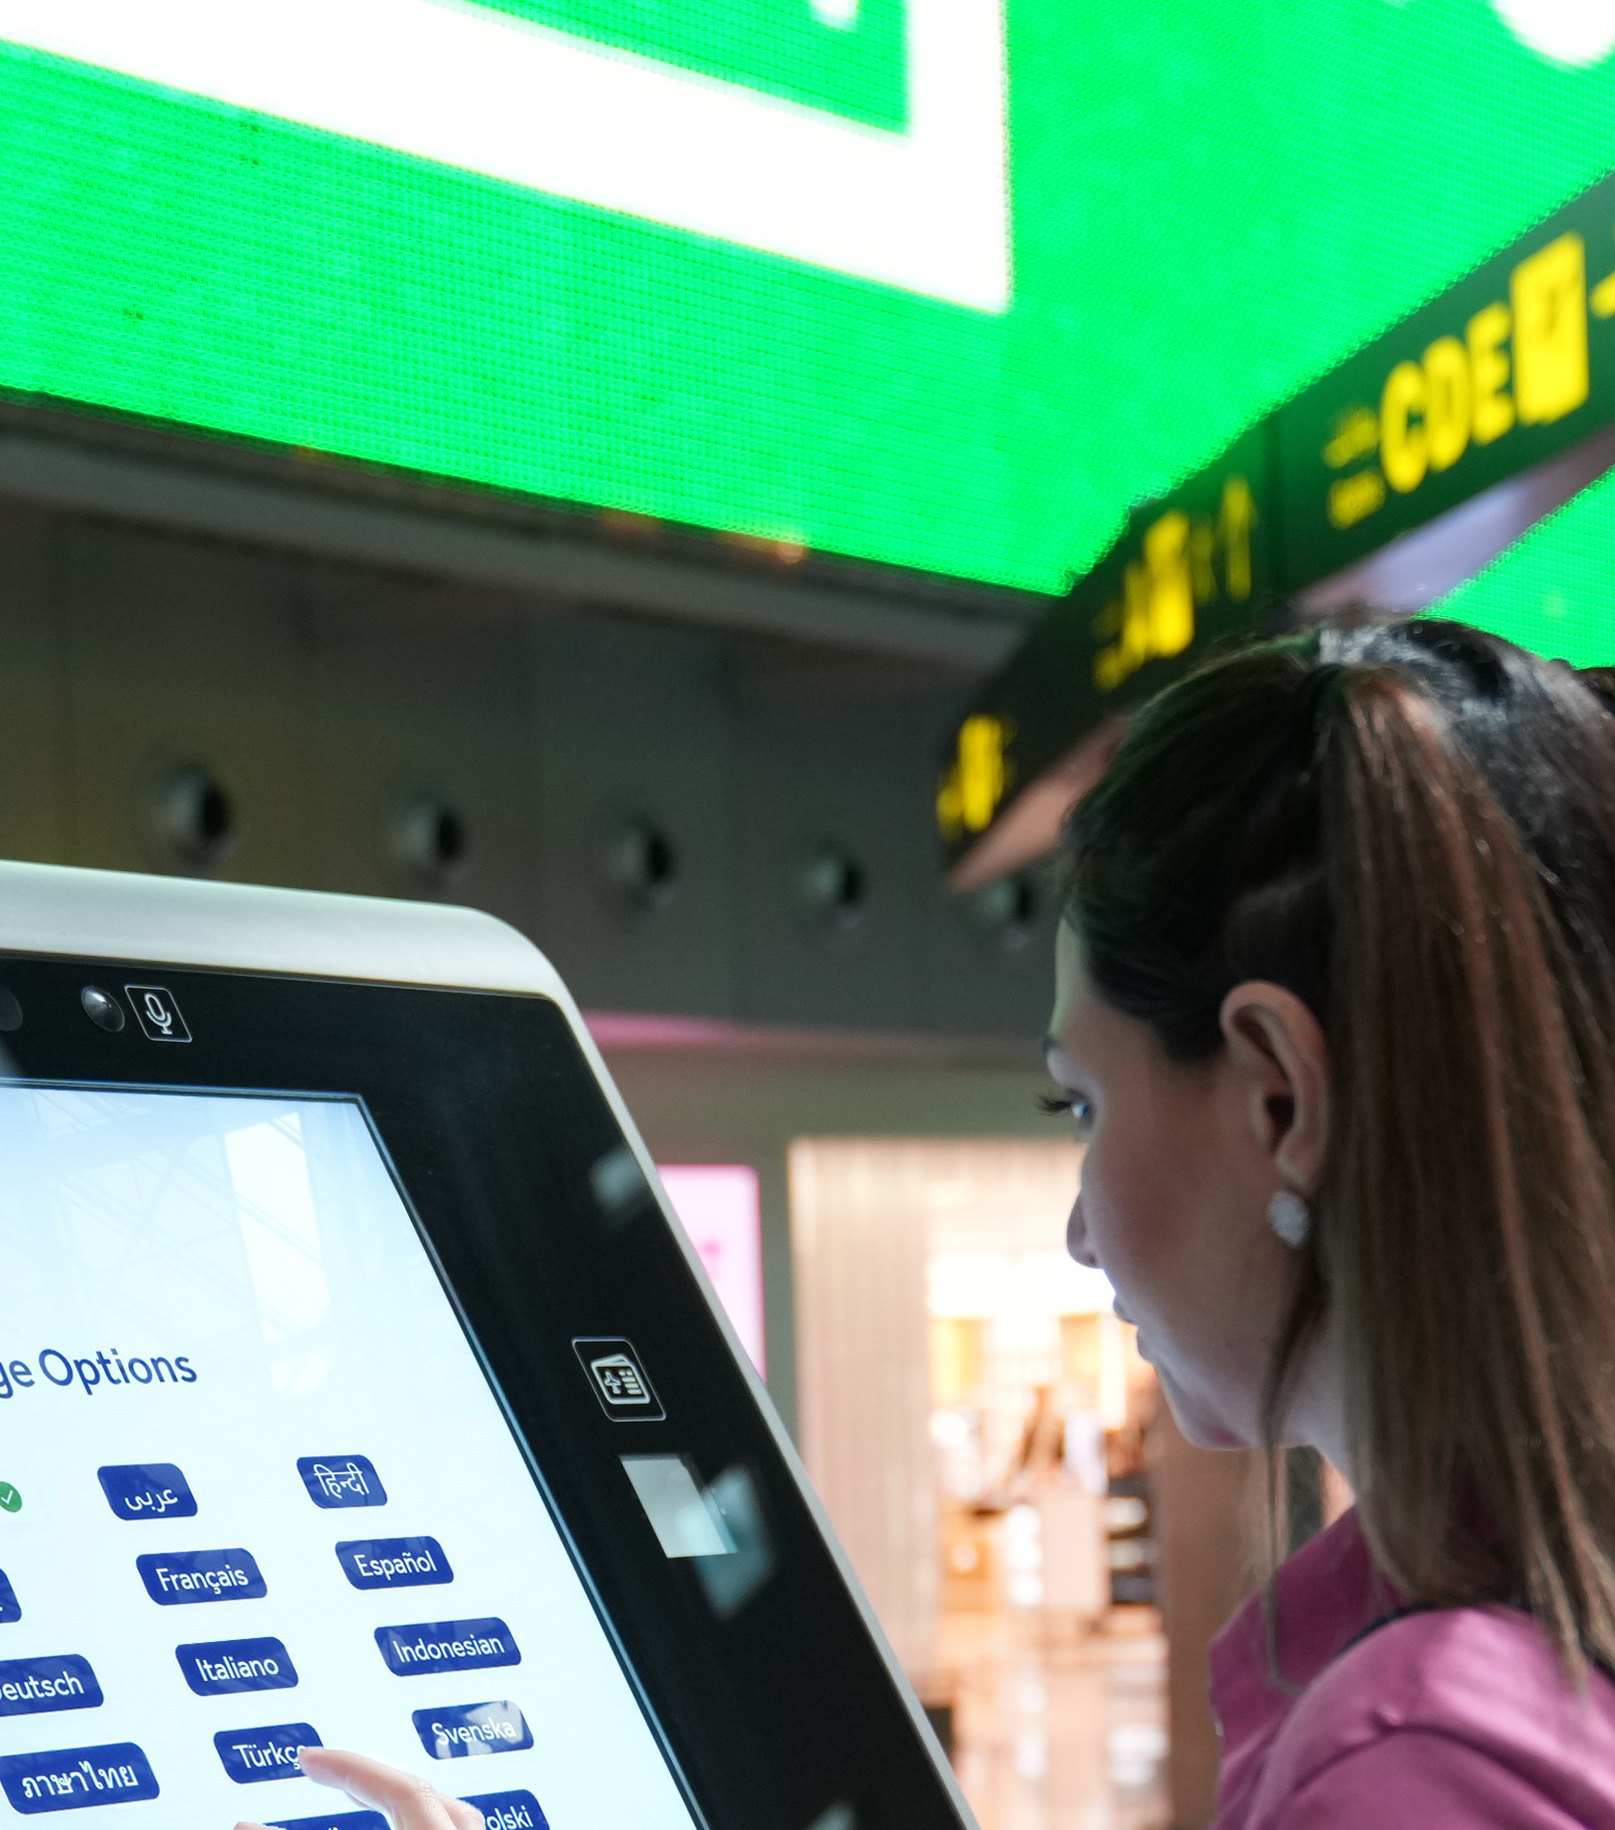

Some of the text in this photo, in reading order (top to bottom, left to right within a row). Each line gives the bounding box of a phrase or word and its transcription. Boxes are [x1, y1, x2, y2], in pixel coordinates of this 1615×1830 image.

[38, 1347, 198, 1396] Options
[312, 1461, 370, 1499] हिन्दी
[155, 1564, 249, 1595] Français
[353, 1549, 437, 1581] Español
[392, 1634, 505, 1663] Indonesian
[195, 1655, 279, 1682] Italiano
[431, 1717, 517, 1746] Svenska
[22, 1760, 139, 1798] ภาษาไทย
